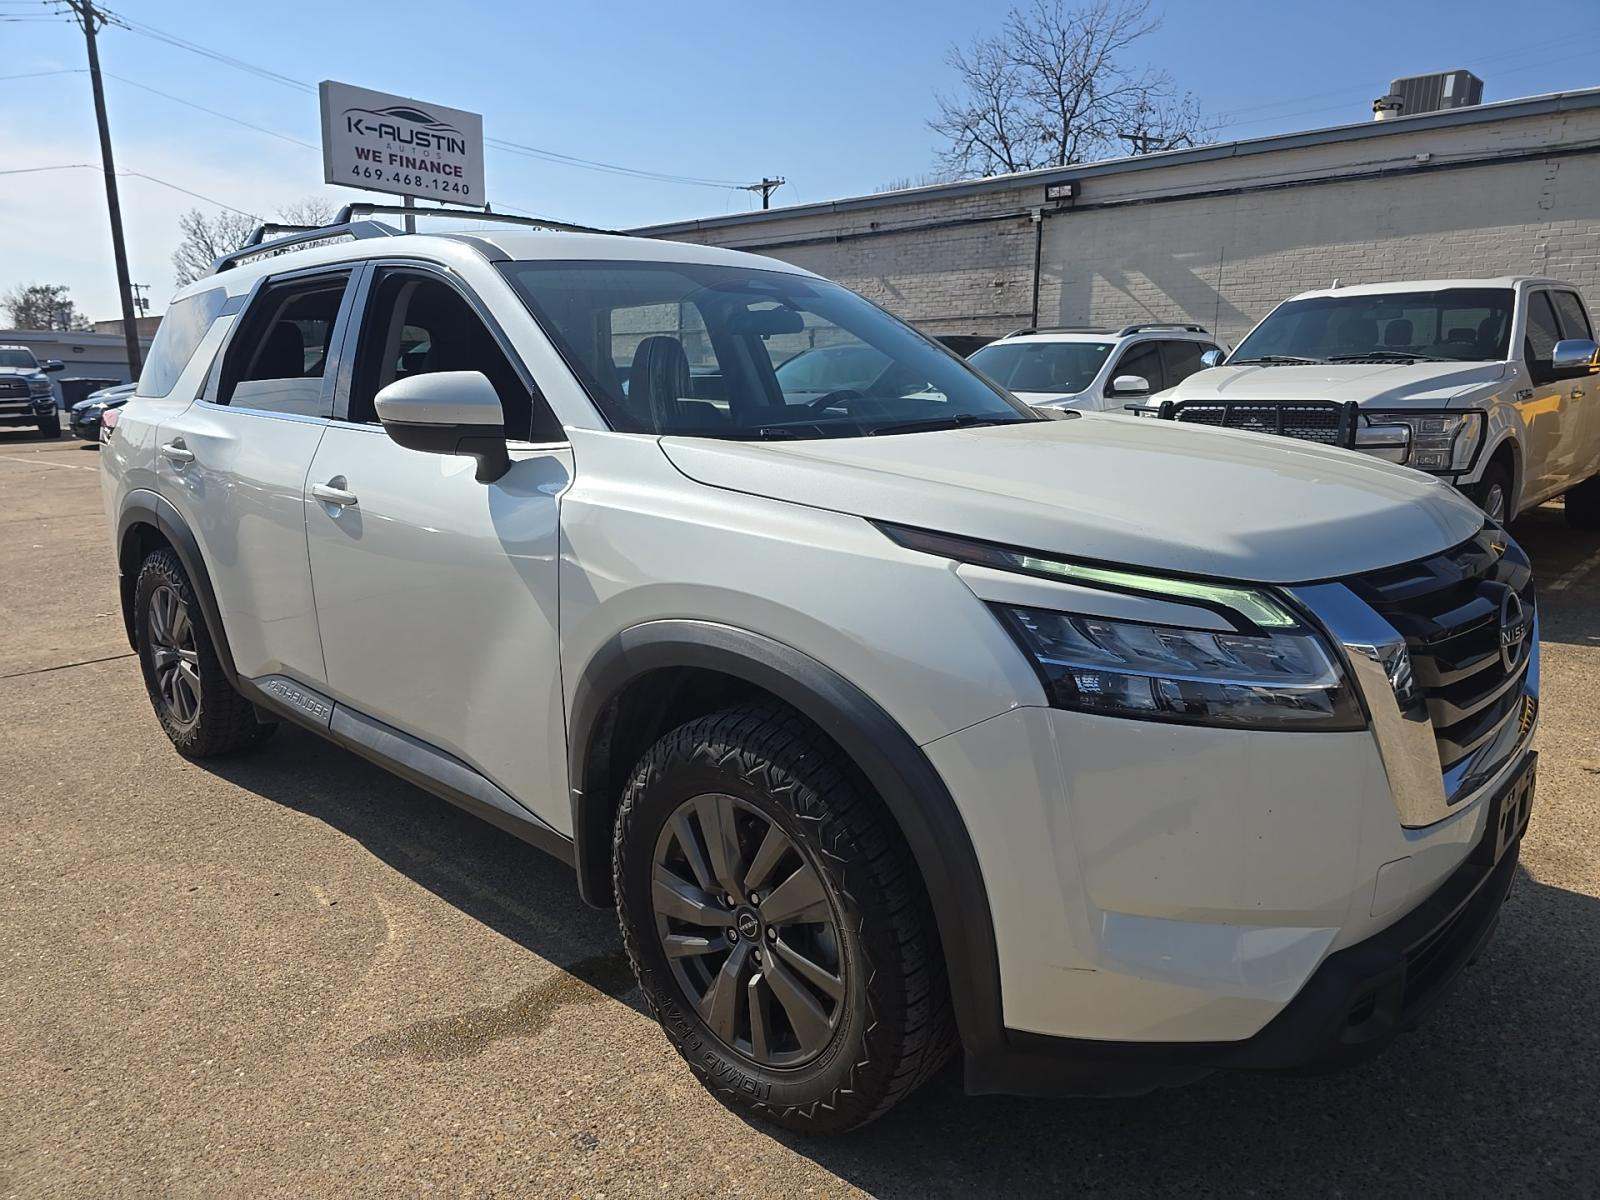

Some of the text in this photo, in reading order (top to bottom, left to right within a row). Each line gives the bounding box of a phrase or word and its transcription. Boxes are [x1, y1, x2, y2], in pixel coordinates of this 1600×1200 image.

[347, 116, 465, 155] K-AUSTIN
[355, 147, 464, 178] WE FINANCE
[352, 165, 470, 195] 469.468.1240
